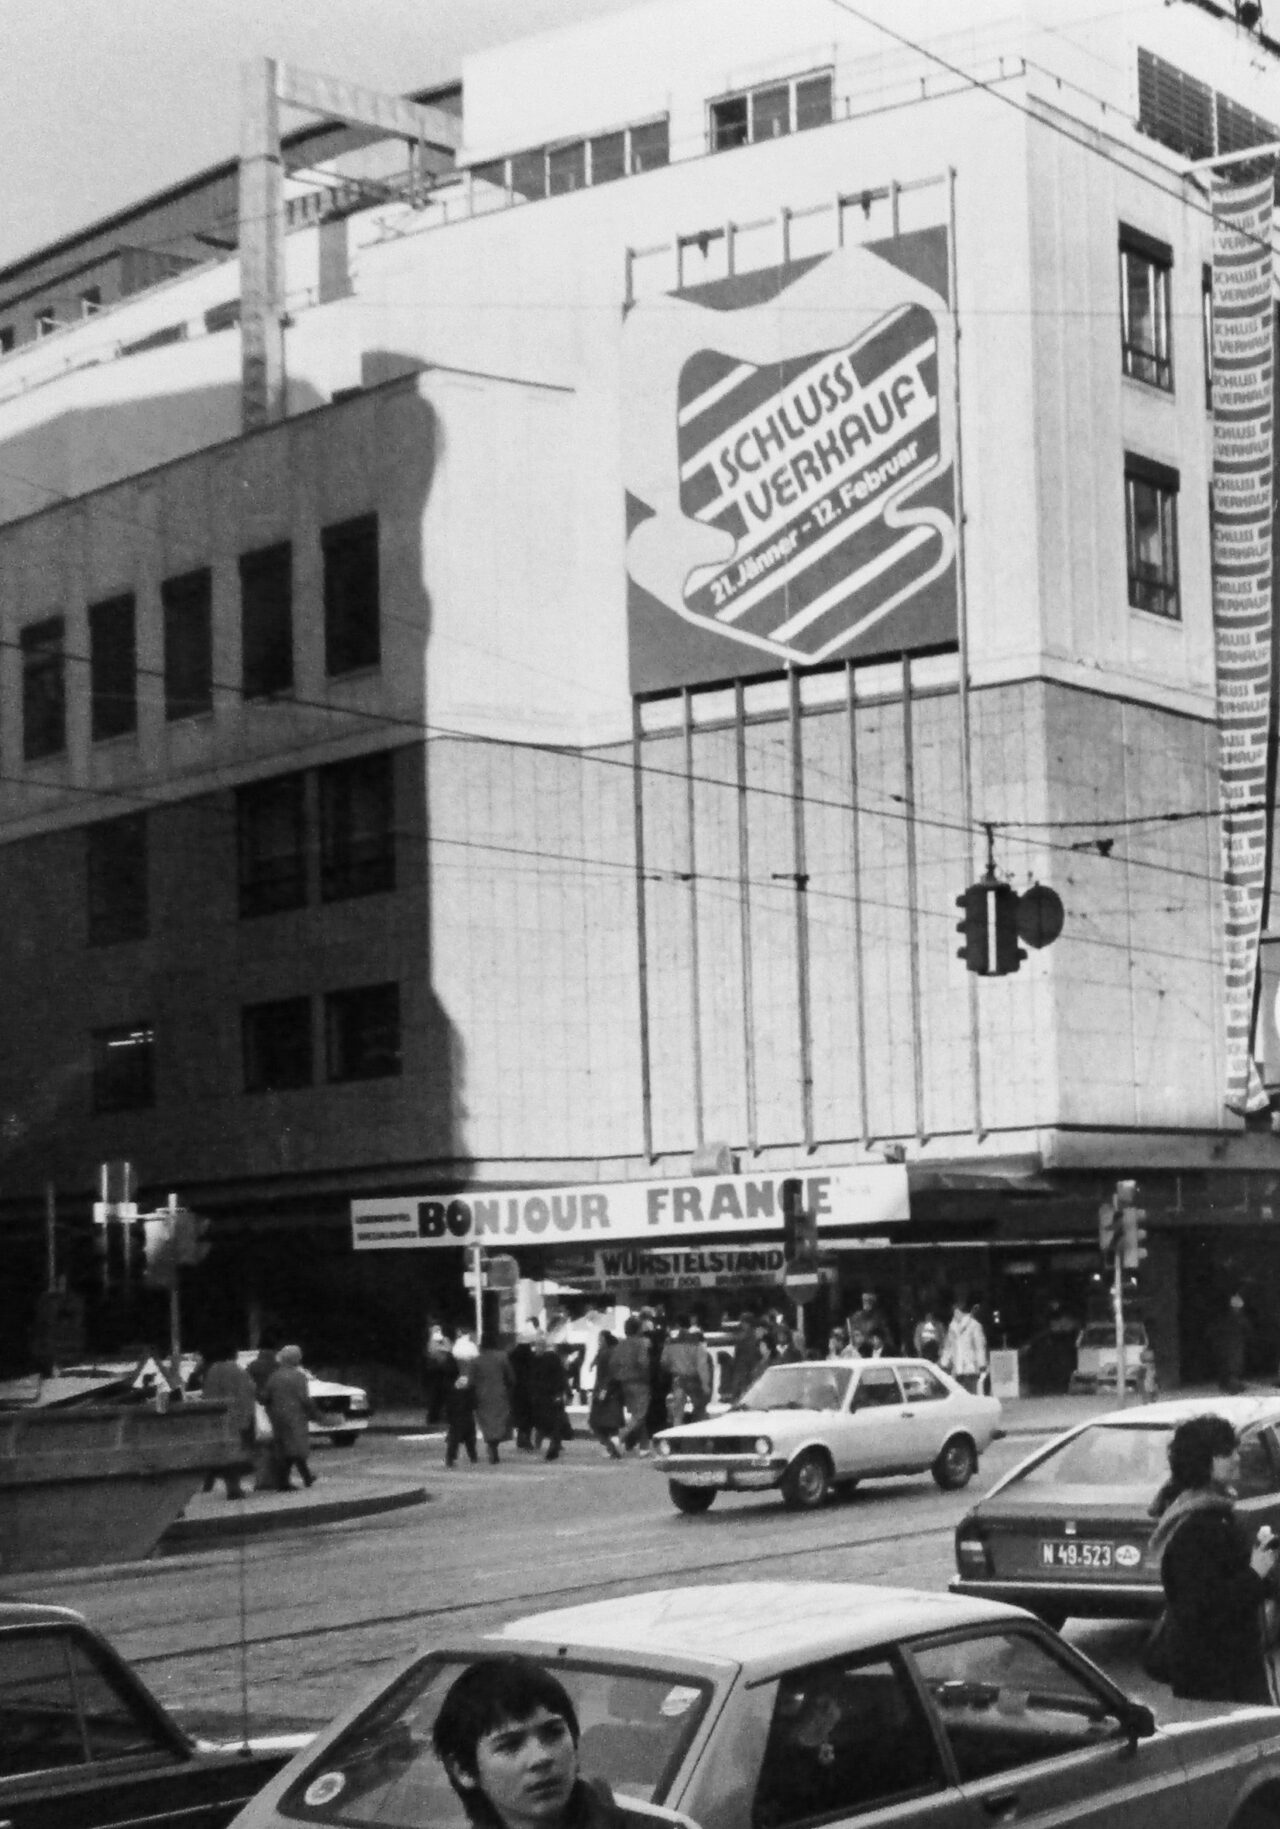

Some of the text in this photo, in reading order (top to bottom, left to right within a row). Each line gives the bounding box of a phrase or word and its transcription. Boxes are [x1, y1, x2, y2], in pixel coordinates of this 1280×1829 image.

[720, 362, 854, 487] SCHLUSS
[744, 375, 916, 520] VERKAUF
[710, 575, 737, 606] 21.
[737, 530, 798, 586] Jänner
[811, 499, 842, 527] 12.
[839, 441, 919, 508] Februar
[418, 1177, 832, 1238] BONJOUR FRANE
[1043, 1543, 1111, 1566] N 49.523
